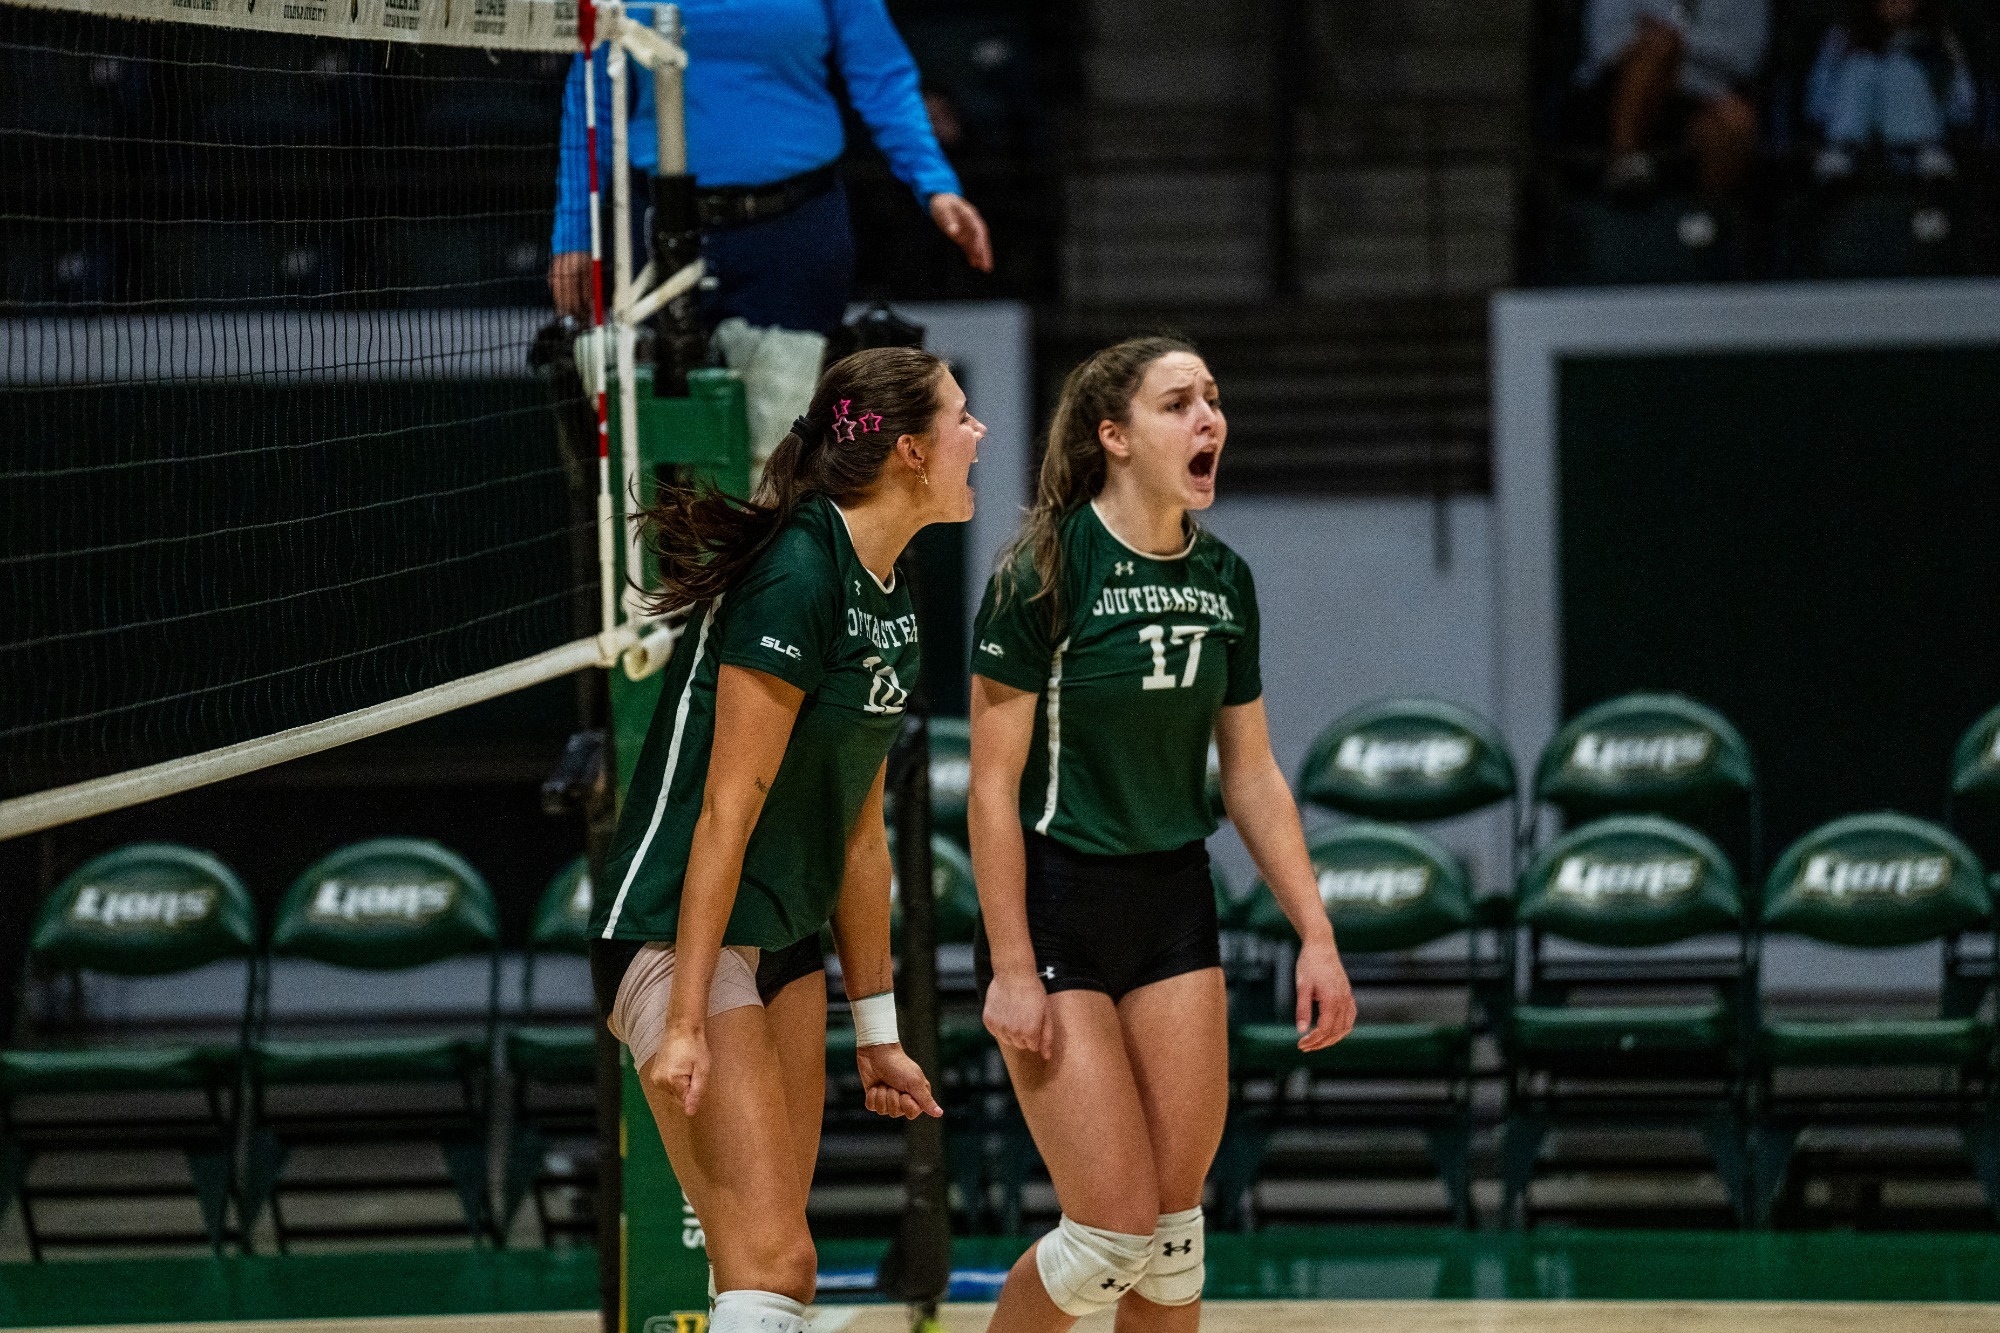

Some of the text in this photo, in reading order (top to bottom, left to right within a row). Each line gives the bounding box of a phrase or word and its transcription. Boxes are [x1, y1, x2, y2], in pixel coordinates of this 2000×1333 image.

[760, 636, 801, 661] SLC
[1138, 624, 1209, 690] 17
[1318, 866, 1429, 905] ions
